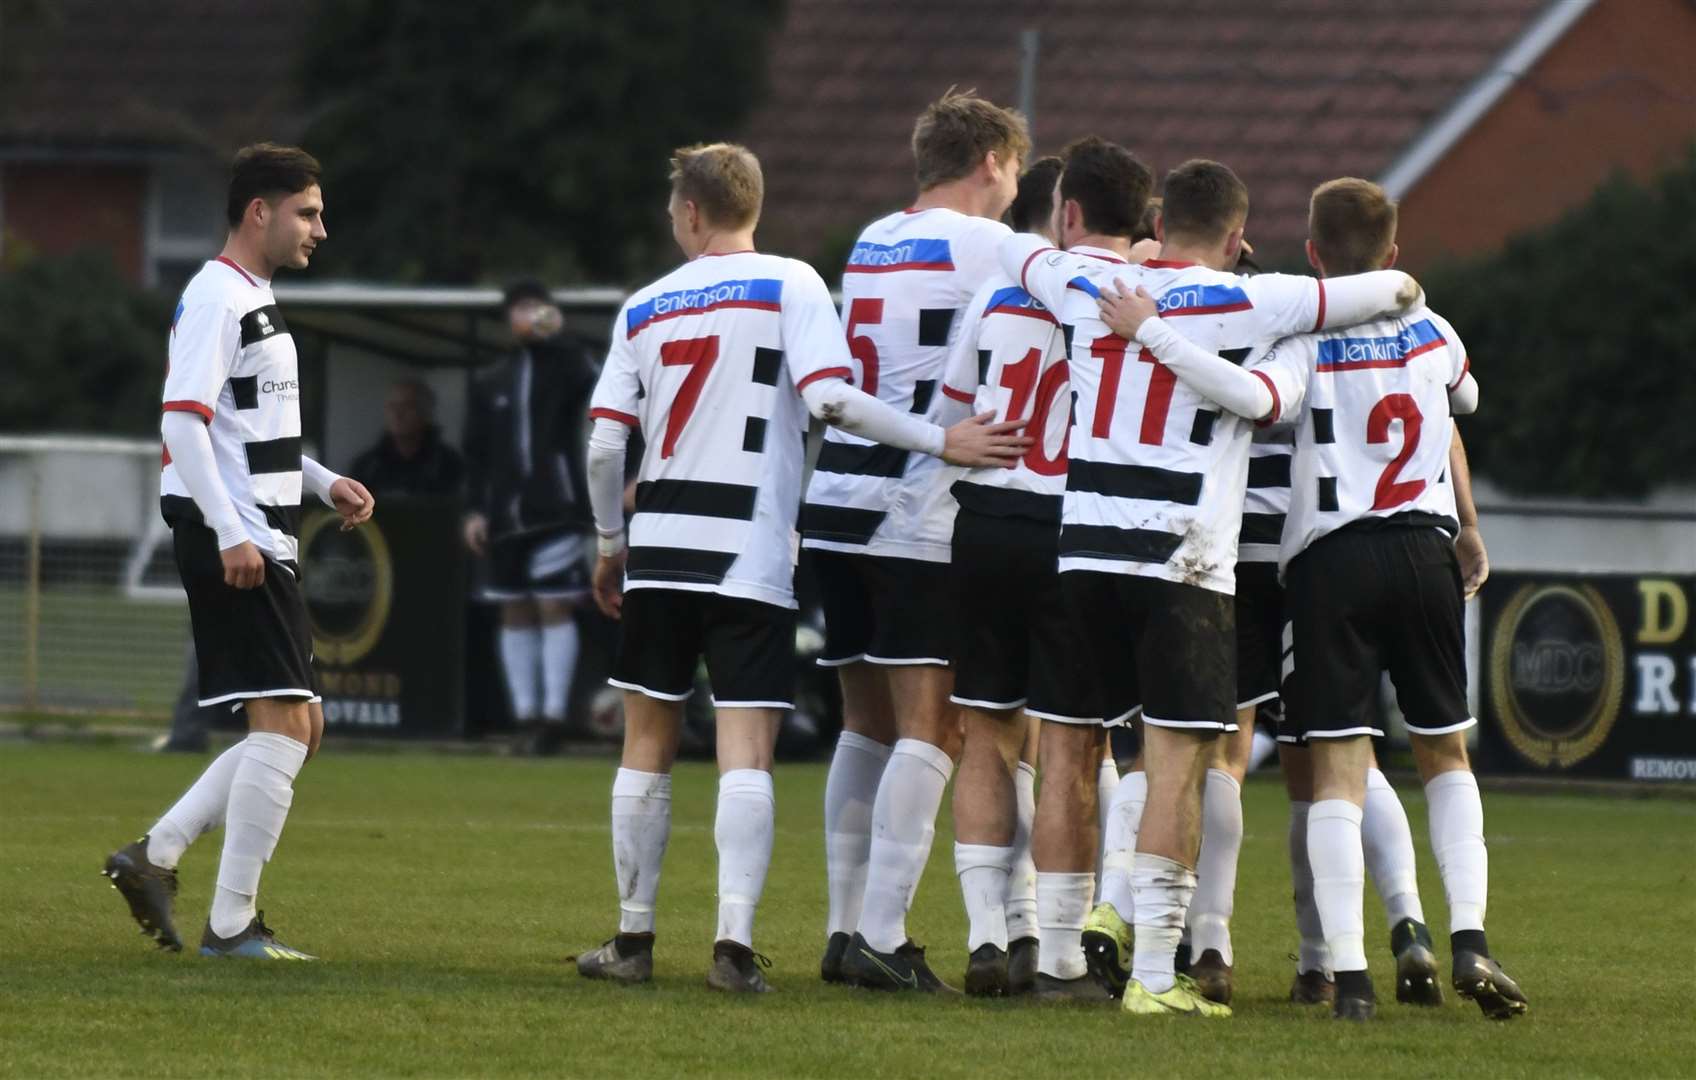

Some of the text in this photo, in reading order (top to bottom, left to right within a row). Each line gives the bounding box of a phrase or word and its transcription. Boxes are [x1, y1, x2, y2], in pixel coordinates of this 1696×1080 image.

[660, 335, 720, 459] 7
[846, 298, 885, 397] 5
[1090, 332, 1178, 446] 11
[999, 347, 1069, 477] 10
[1367, 393, 1427, 511] 2
[320, 672, 400, 697] MOND
[323, 702, 400, 724] OVALS
[1636, 655, 1696, 713] R
